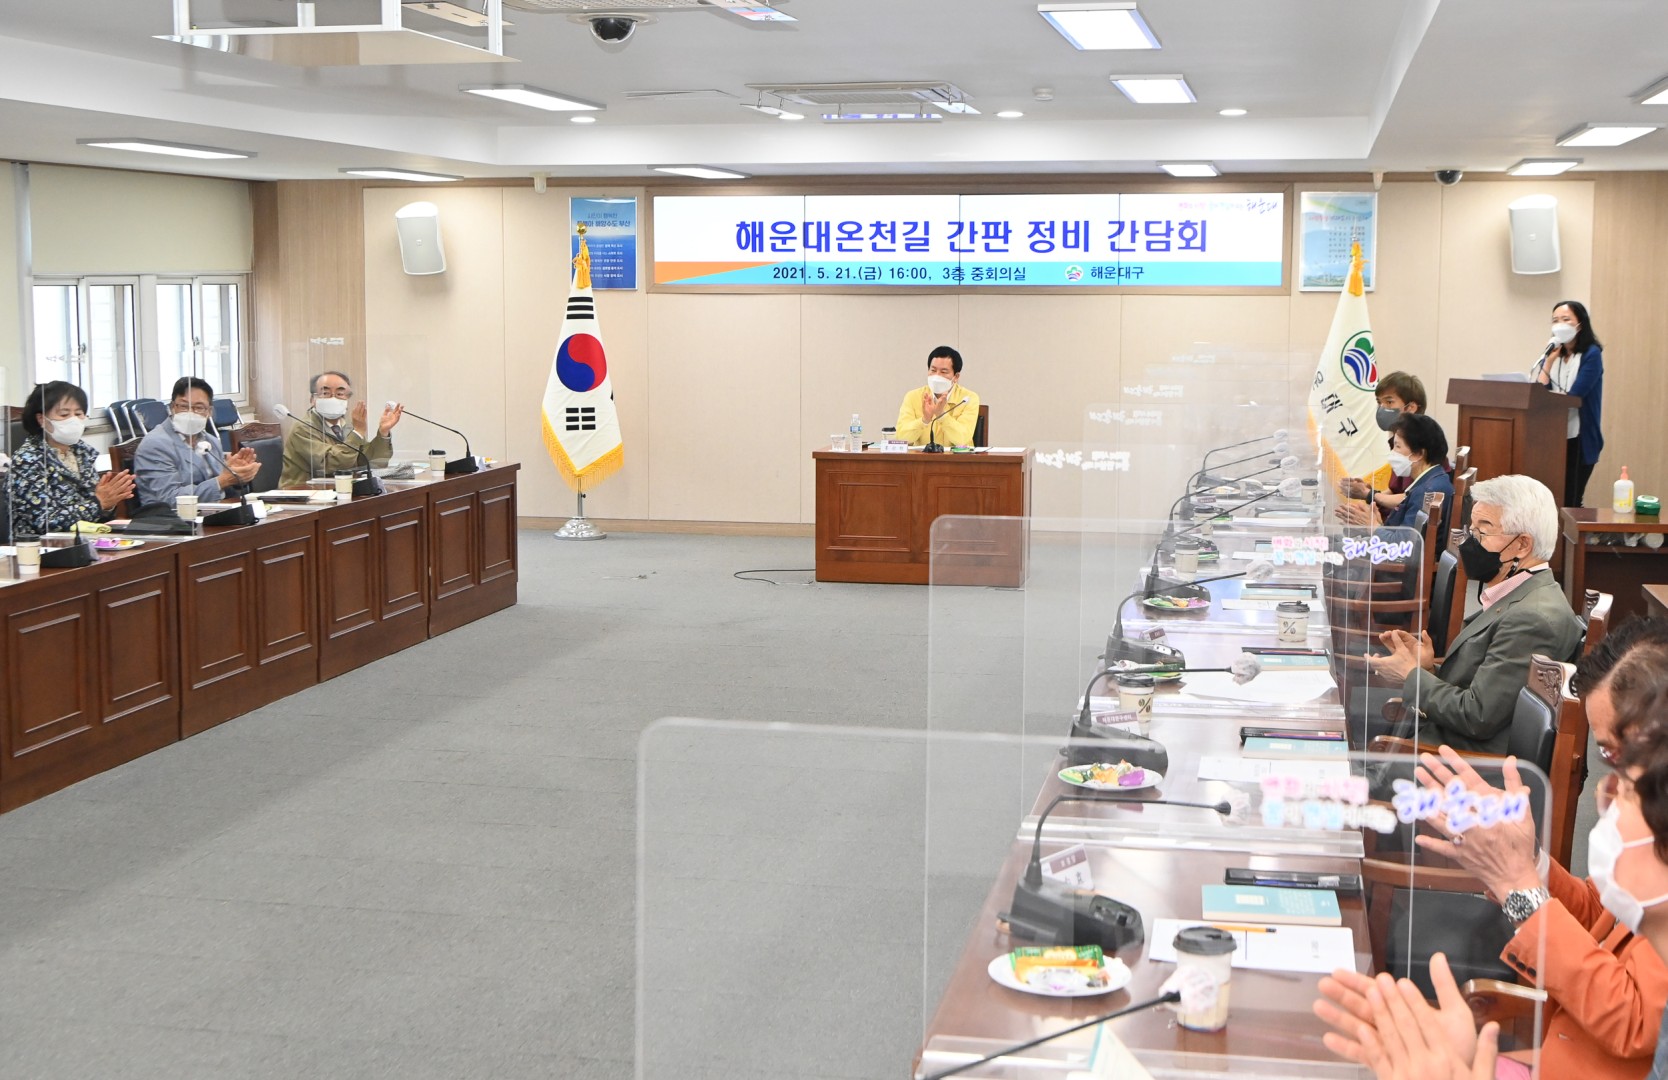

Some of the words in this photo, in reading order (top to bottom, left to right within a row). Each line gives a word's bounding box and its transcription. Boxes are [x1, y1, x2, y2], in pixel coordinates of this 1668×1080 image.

[735, 220, 930, 253] 해운대온천길
[946, 220, 1013, 253] 간판
[1026, 220, 1090, 254] 정비
[1107, 219, 1207, 253] 간담회
[772, 267, 811, 280] 2021.
[817, 267, 829, 280] 5.
[835, 266, 882, 281] 21.(금)
[889, 267, 932, 282] 16:00,
[942, 267, 966, 282] 3층
[970, 267, 1026, 282] 중회의실
[1090, 266, 1145, 281] 해운대구
[1342, 535, 1413, 564] 해운대
